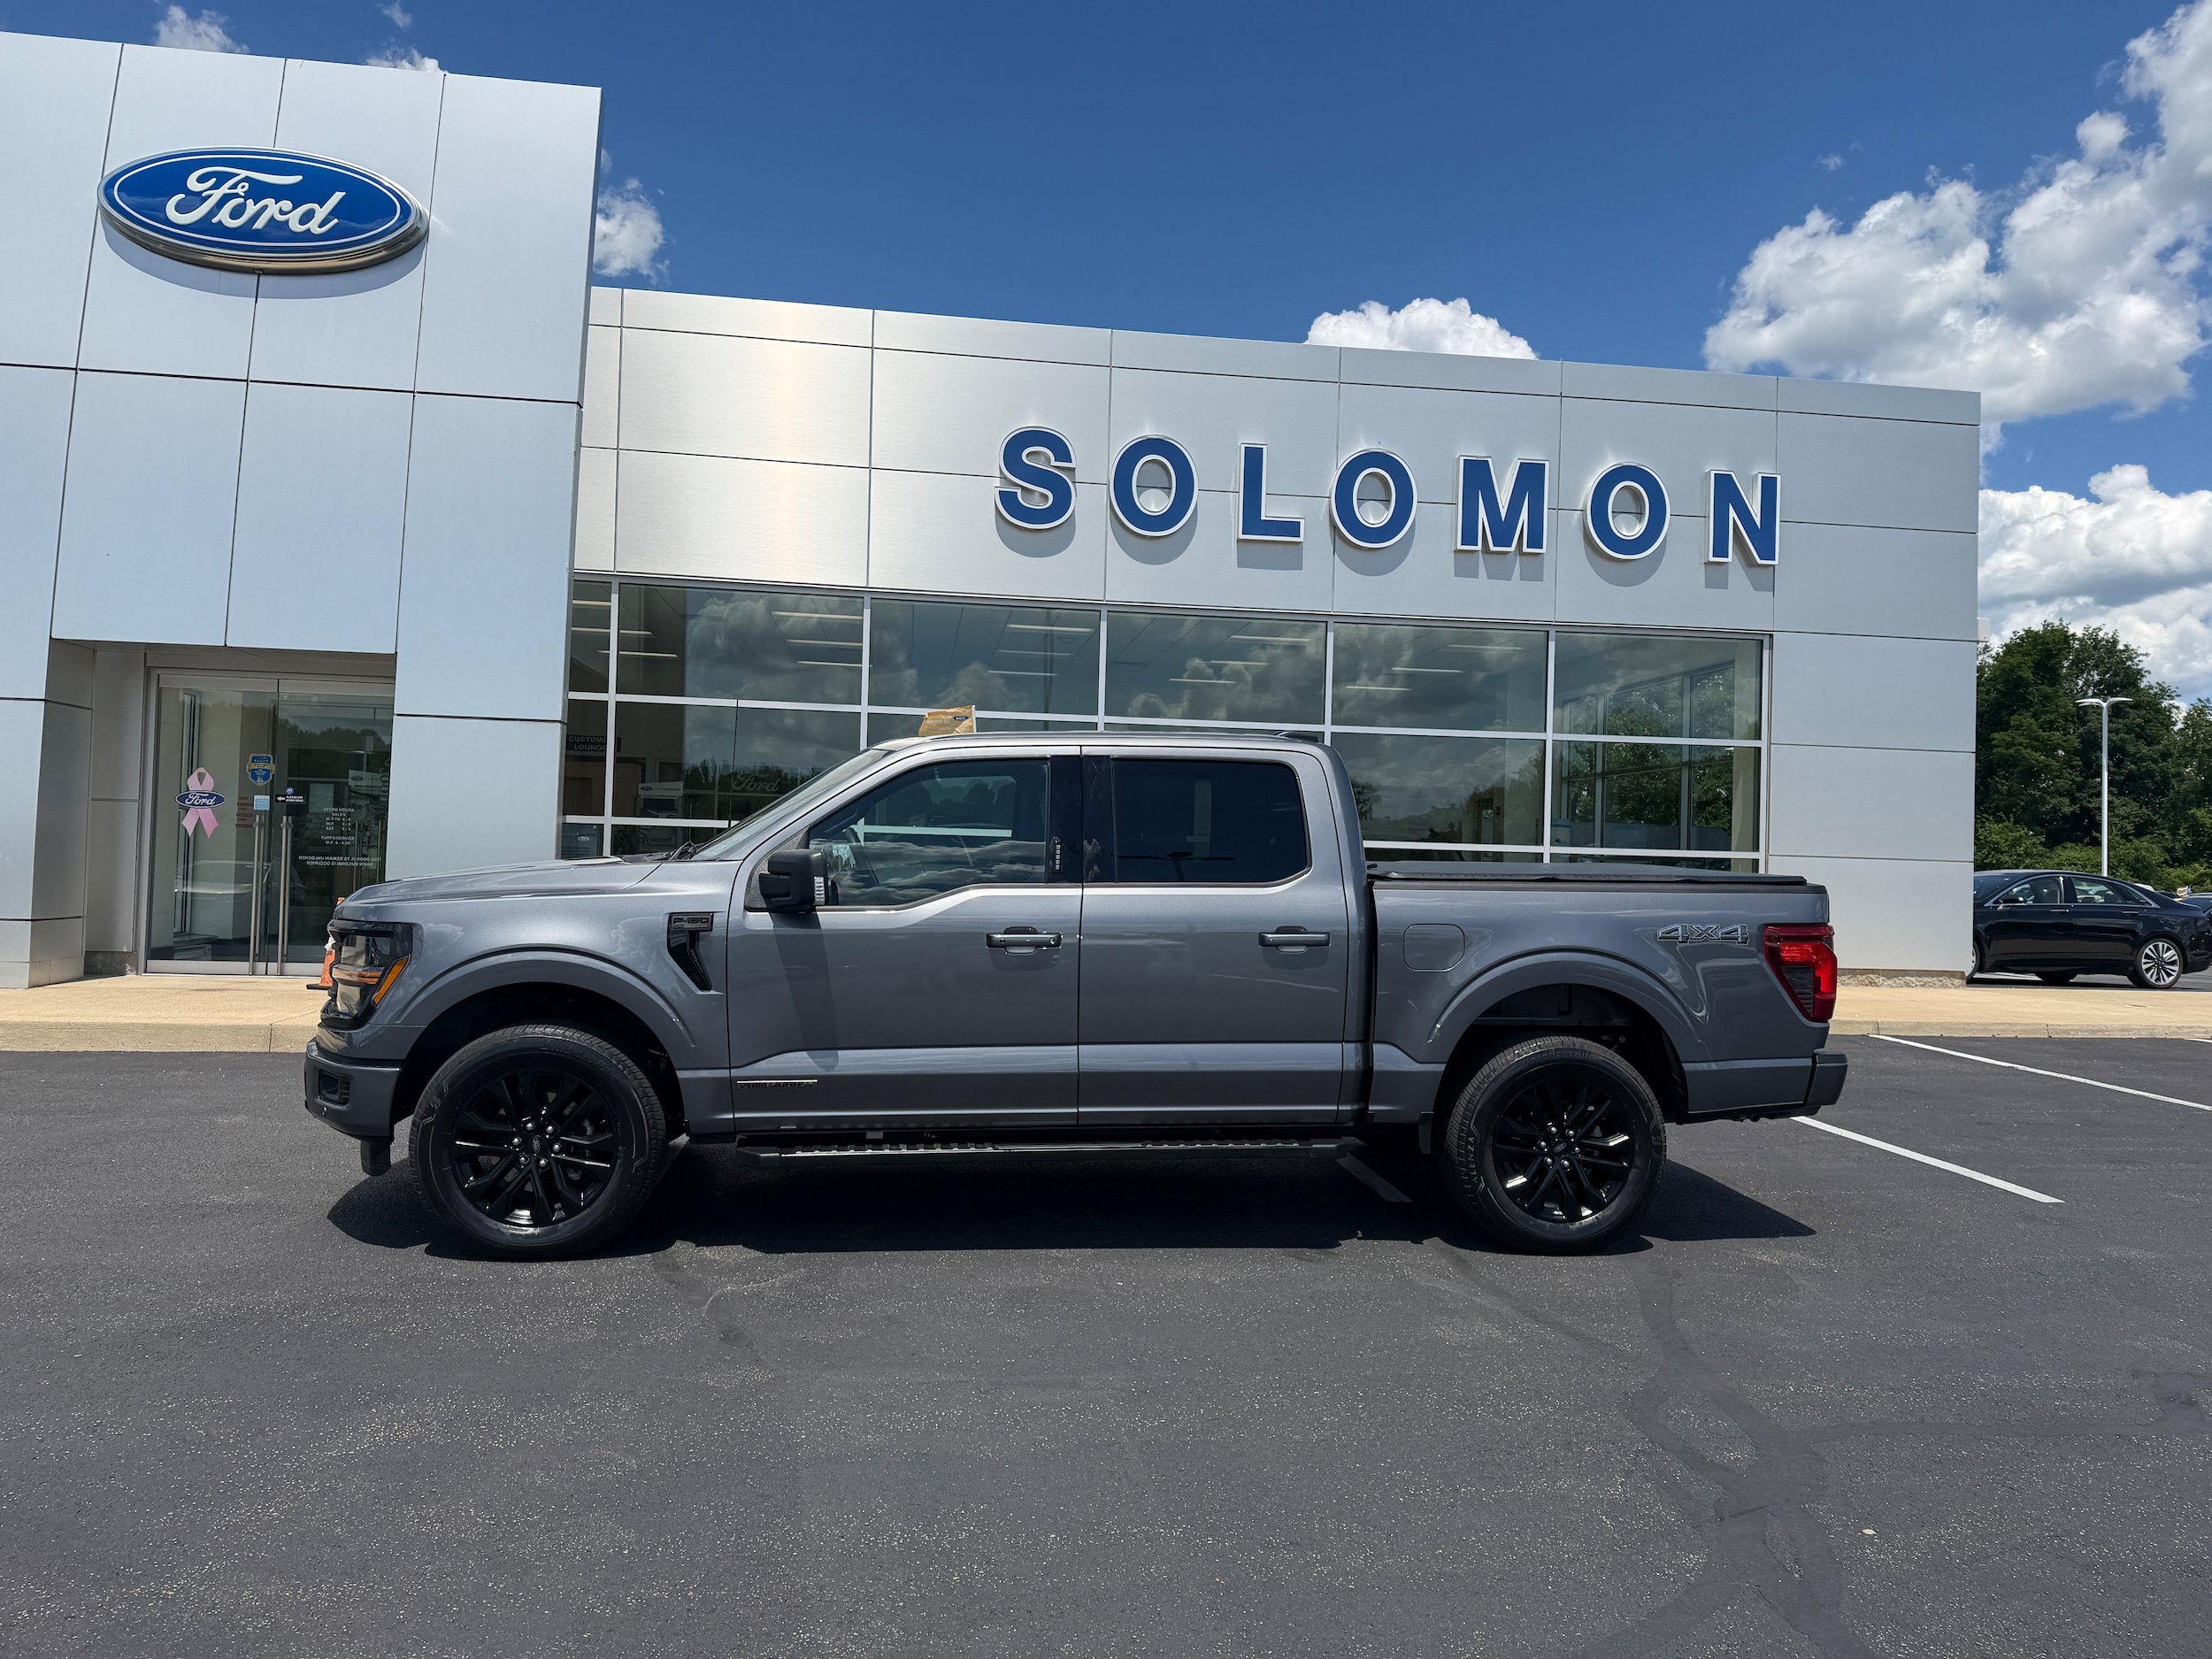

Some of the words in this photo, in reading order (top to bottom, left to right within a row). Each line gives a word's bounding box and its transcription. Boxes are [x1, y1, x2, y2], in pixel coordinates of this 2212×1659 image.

[165, 165, 346, 235] Ford
[994, 425, 1781, 566] SOLOMON
[185, 792, 217, 805] Ford
[732, 772, 782, 792] Ford
[1467, 1136, 1479, 1183] ALENZA
